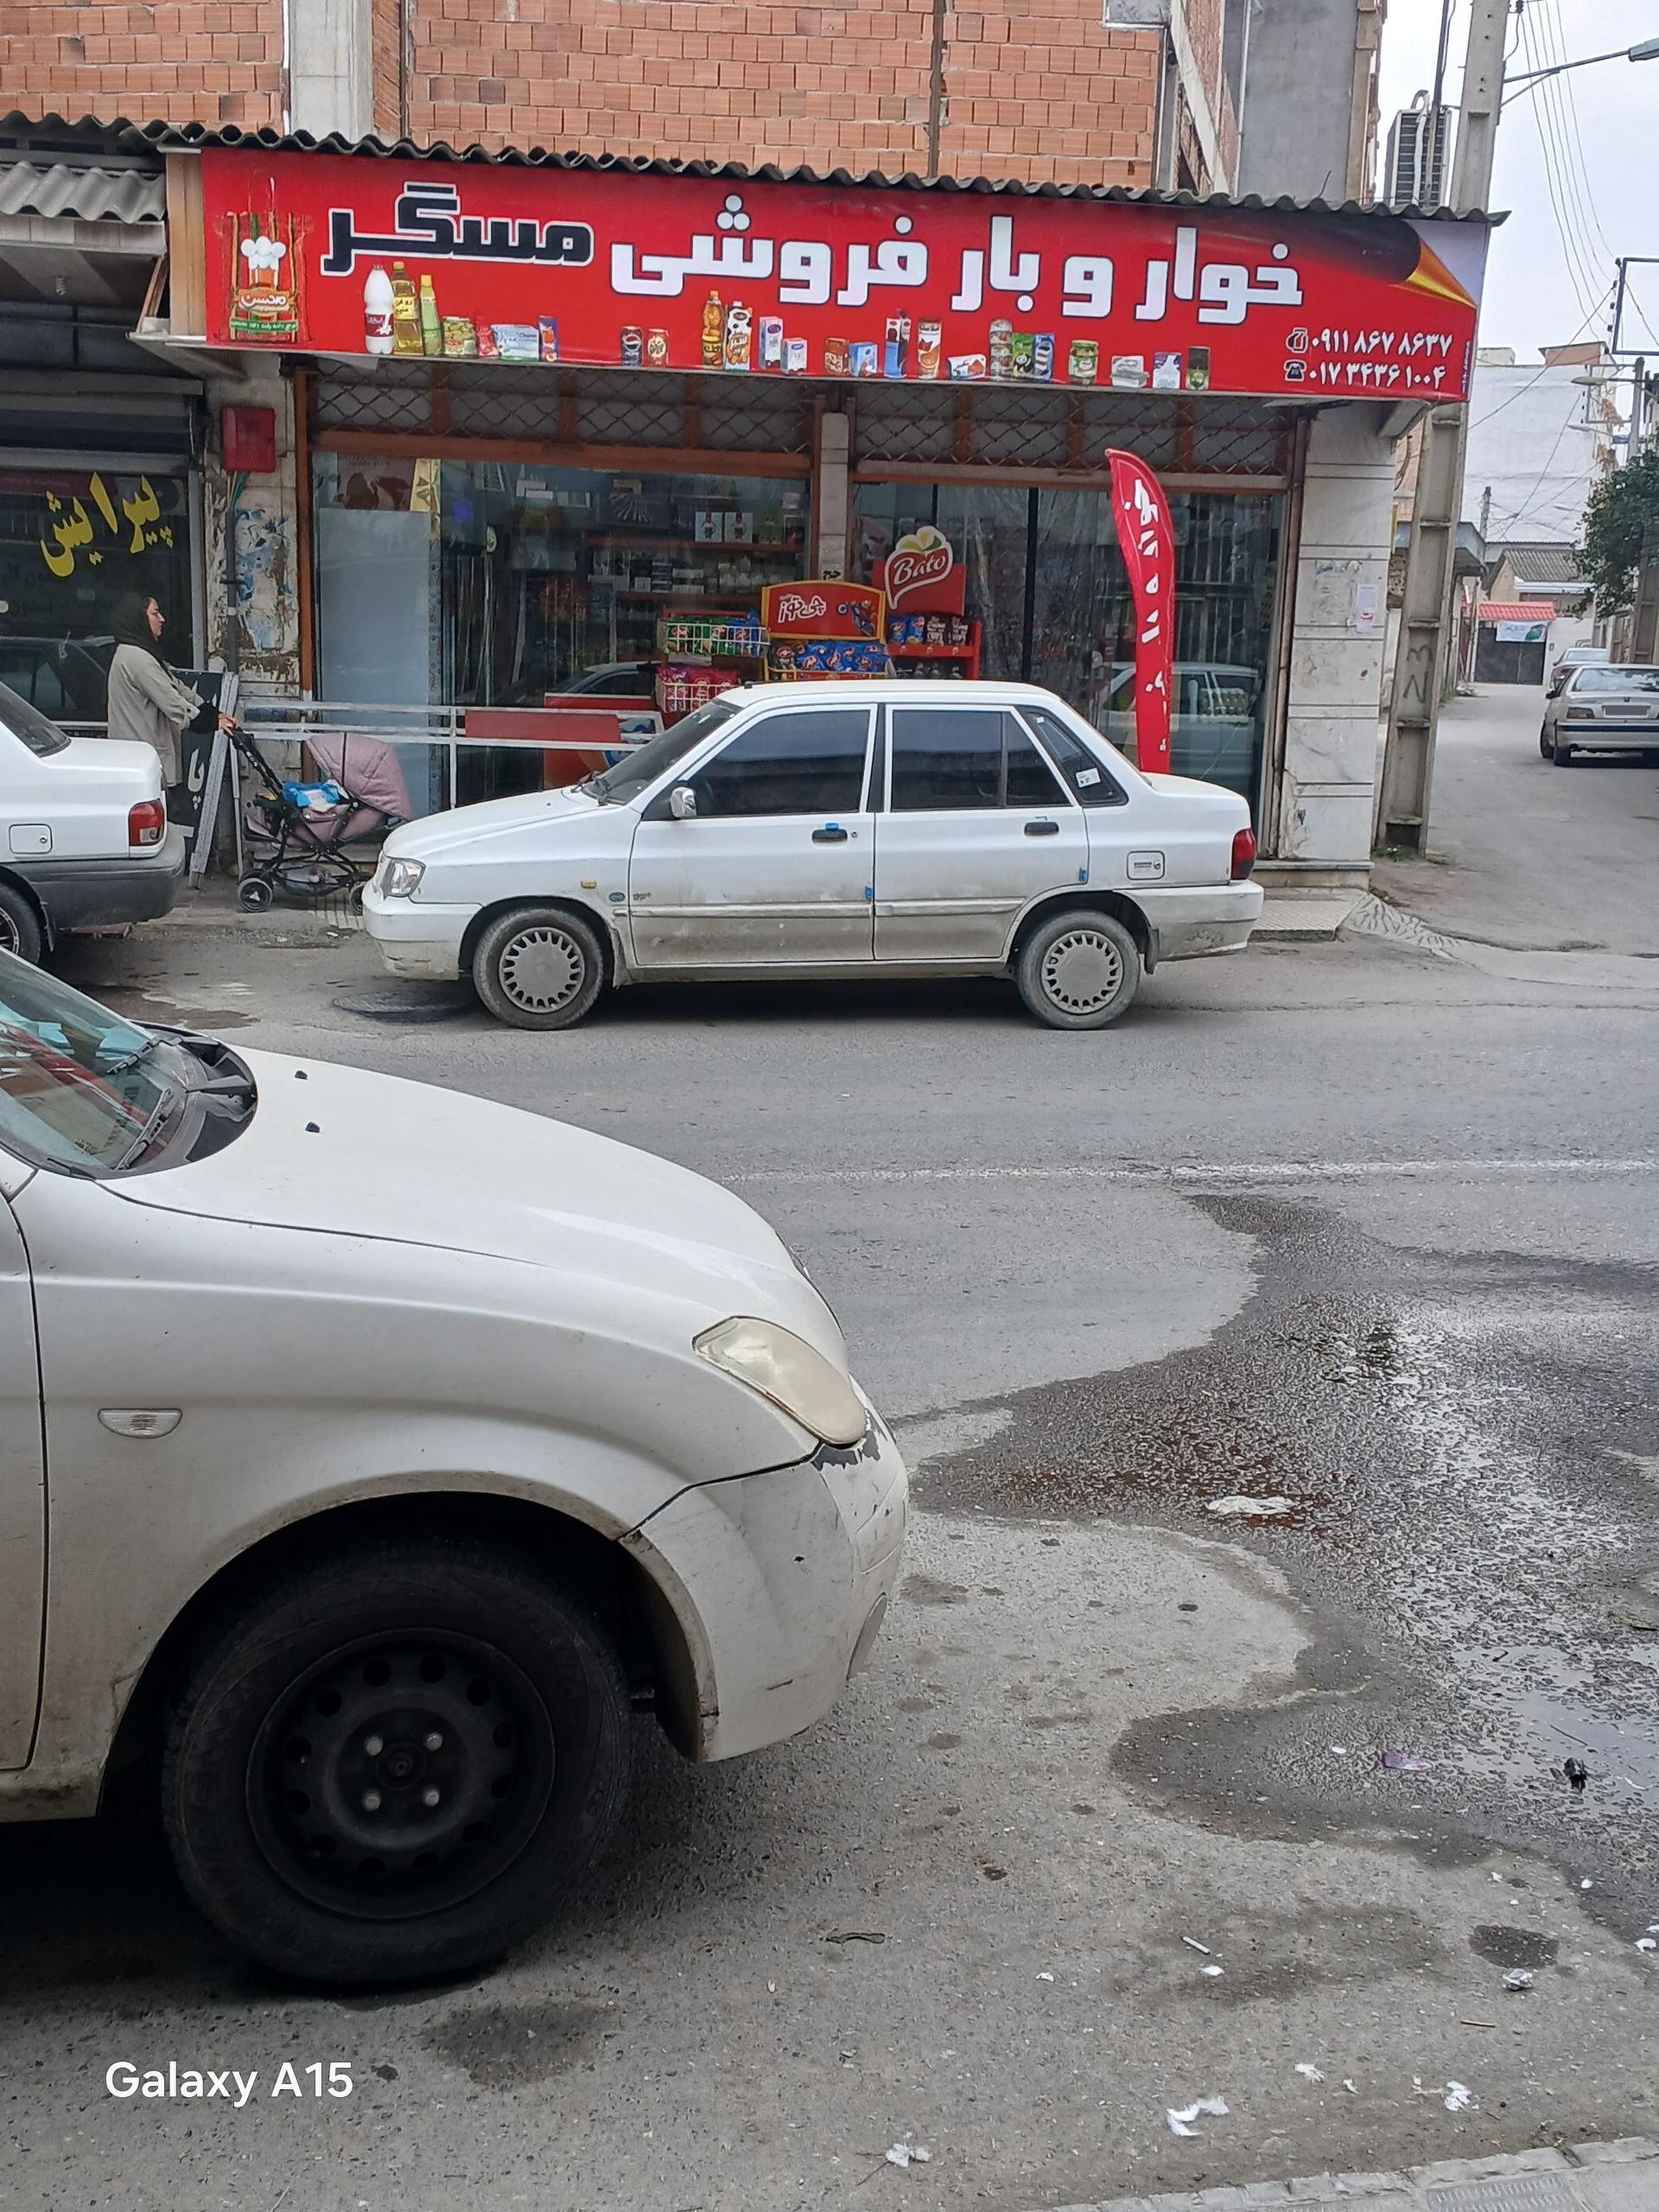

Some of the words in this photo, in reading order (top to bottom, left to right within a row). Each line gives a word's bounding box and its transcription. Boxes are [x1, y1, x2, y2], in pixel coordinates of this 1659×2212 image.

[321, 181, 594, 276] مسگر
[611, 194, 929, 307] فروشی
[950, 214, 1041, 313] بار
[1135, 226, 1303, 325] خوار
[1062, 255, 1115, 318] و
[40, 471, 174, 578] پیرایش
[893, 555, 946, 585] Bato
